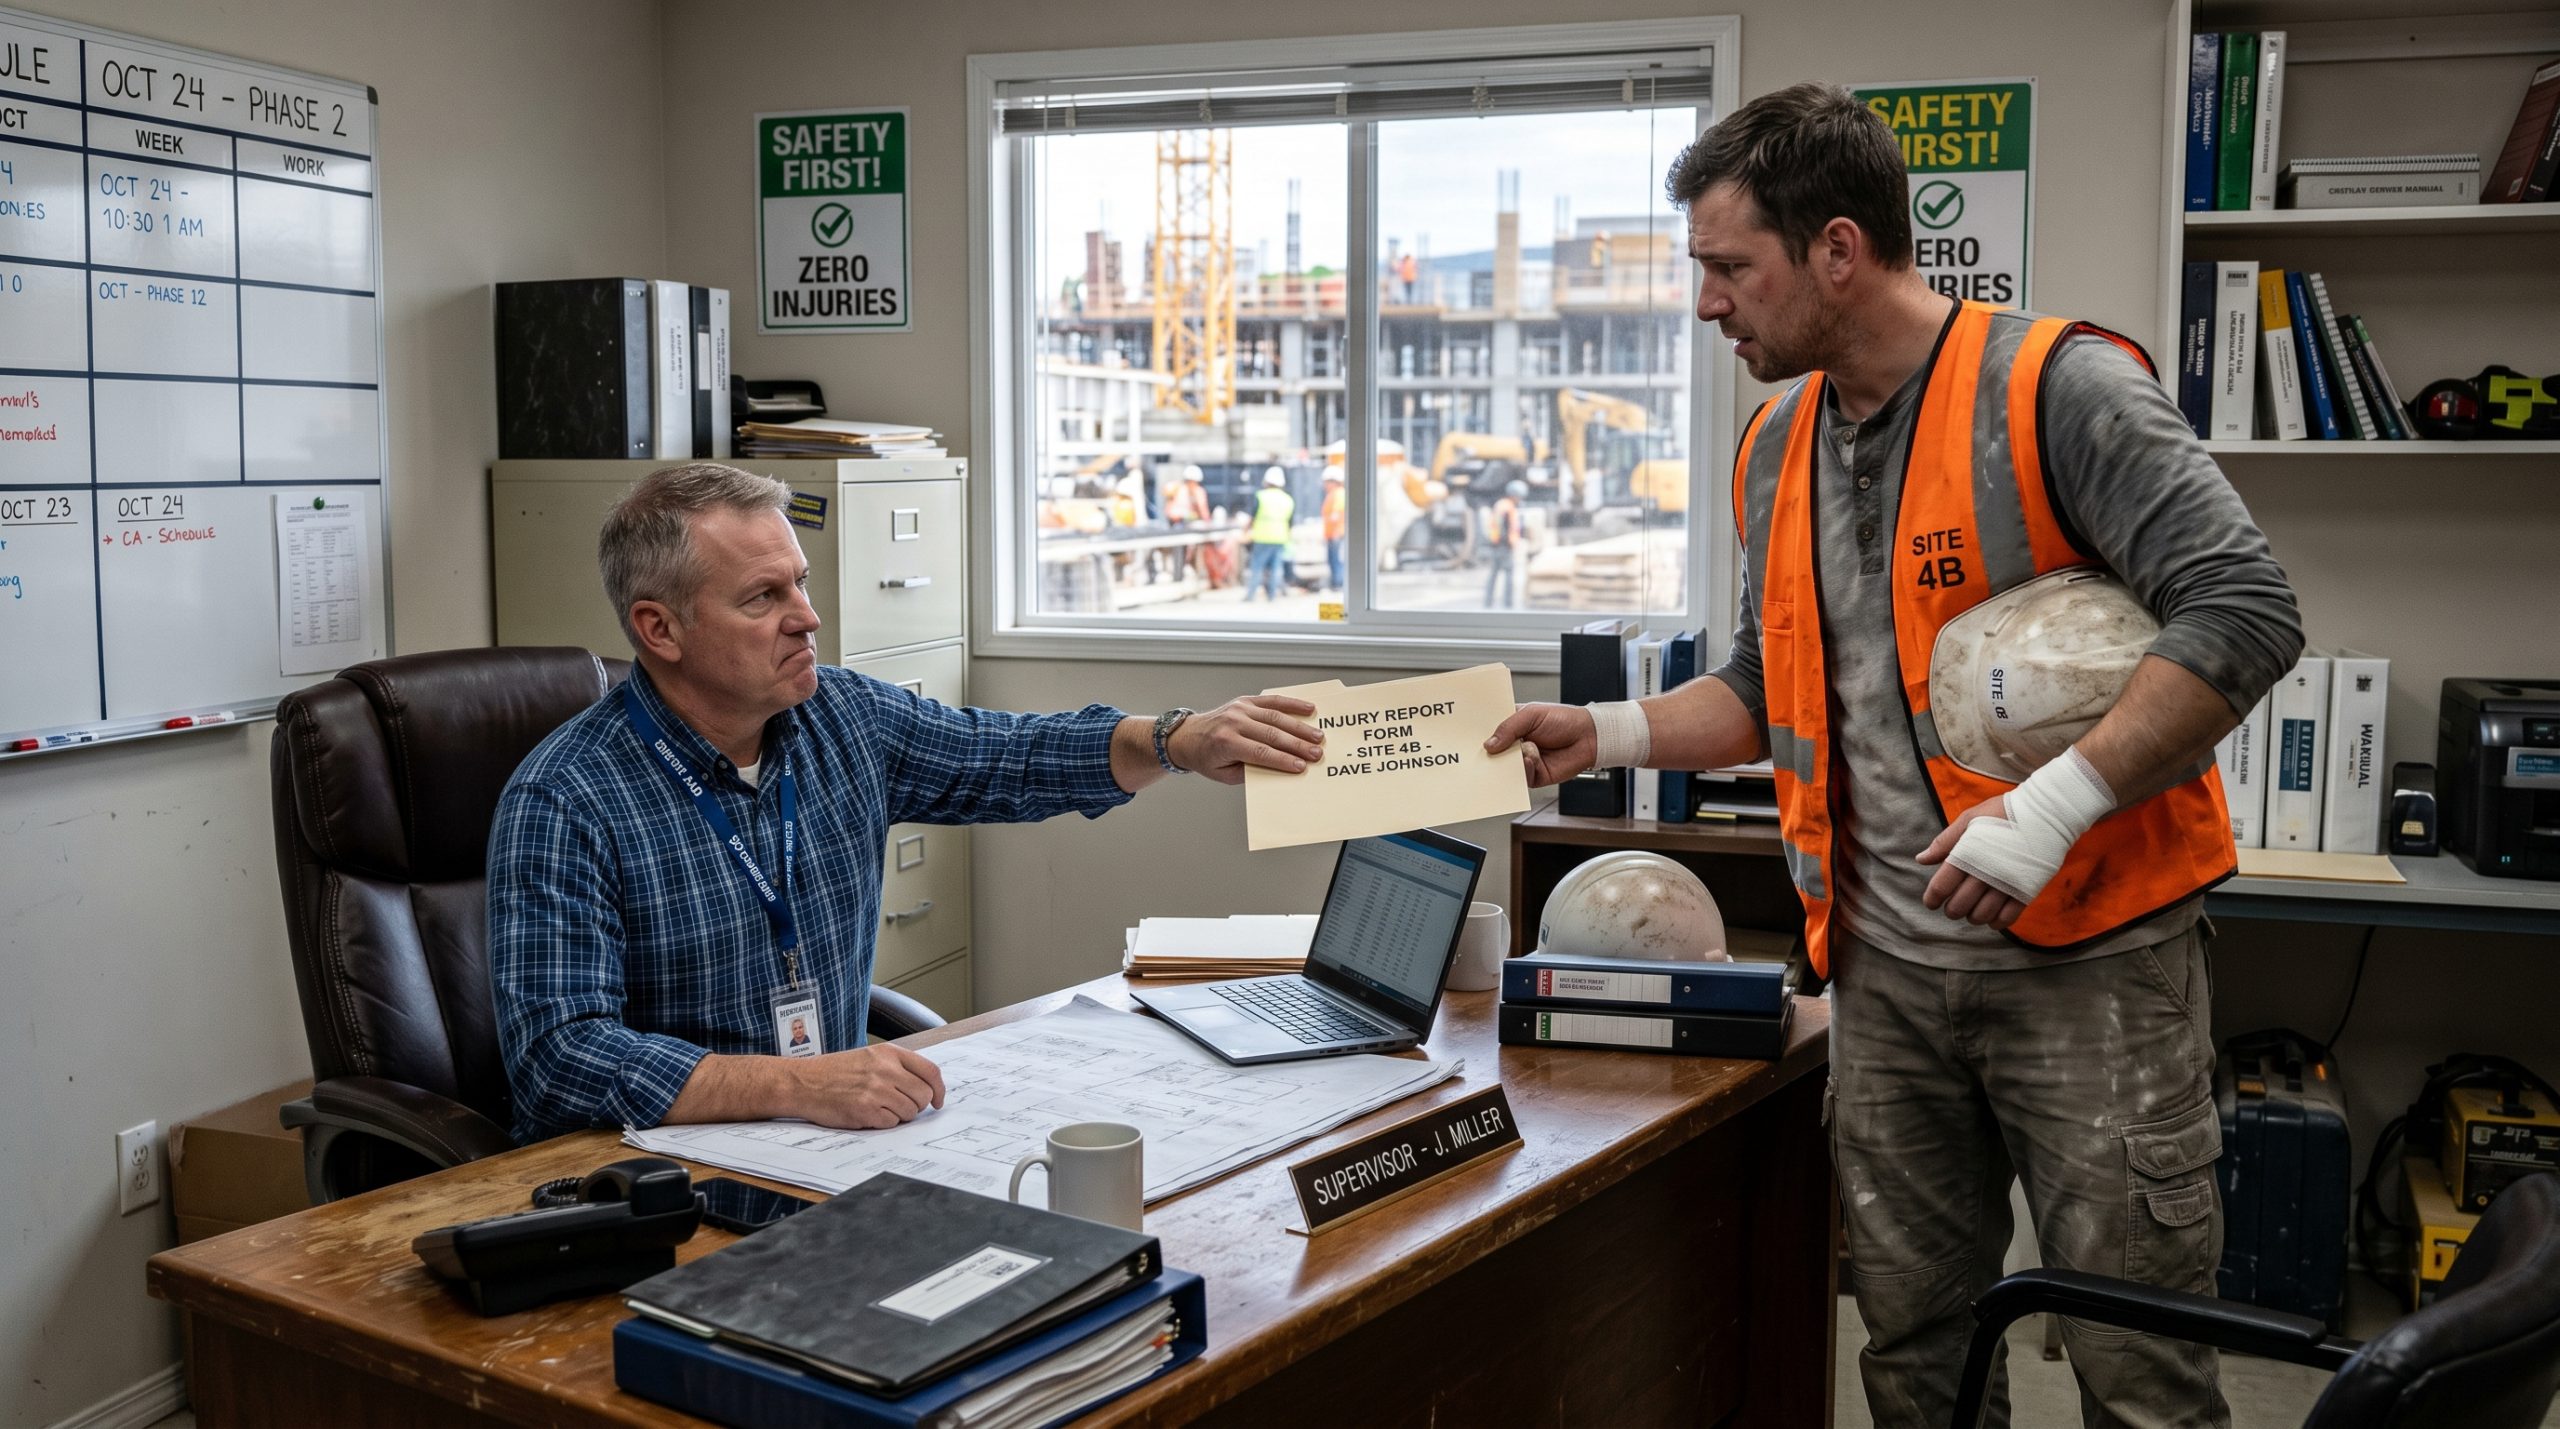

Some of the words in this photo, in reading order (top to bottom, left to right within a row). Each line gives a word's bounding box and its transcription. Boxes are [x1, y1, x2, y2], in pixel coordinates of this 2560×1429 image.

[102, 60, 157, 101] OCT
[172, 73, 205, 112] 24
[249, 86, 320, 131] PHASE
[332, 104, 347, 137] 2
[1868, 92, 2013, 129] SAFETY
[0, 107, 28, 129] CT
[136, 129, 183, 155] WEEK
[773, 121, 891, 156] SAFETY
[1894, 131, 1999, 166] IRST!
[283, 154, 326, 177] WORK
[783, 157, 880, 191] FIRST!
[101, 173, 139, 198] OCT
[150, 179, 172, 202] 24
[103, 208, 154, 233] 10:30
[163, 214, 170, 235] 1
[178, 217, 204, 238] AM
[1915, 237, 1980, 267] ERO
[799, 255, 869, 284] ZERO
[99, 281, 129, 300] OCT
[147, 284, 185, 304] PHASE
[191, 288, 207, 306] 12
[773, 288, 897, 317] INJURIES
[1929, 273, 2013, 303] RIES
[1, 499, 36, 520] OCT
[47, 496, 72, 518] 23
[118, 497, 153, 517] OCT
[162, 495, 183, 516] 24
[122, 530, 143, 547] CA
[1912, 528, 1964, 557] SITE
[1917, 556, 1966, 590] 4B
[1992, 668, 2004, 700] SITE
[1319, 711, 1380, 730] INJURY
[1385, 701, 1455, 722] REPORT
[1363, 725, 1413, 741] FORM
[1357, 744, 1395, 758] SITE
[1399, 741, 1421, 754] 4B
[1327, 763, 1372, 777] DAVE
[1376, 753, 1459, 773] JOHNSON
[1313, 1143, 1417, 1205] SUPERVISOR
[1434, 1130, 1449, 1157] J.
[1449, 1107, 1504, 1149] MILLER
